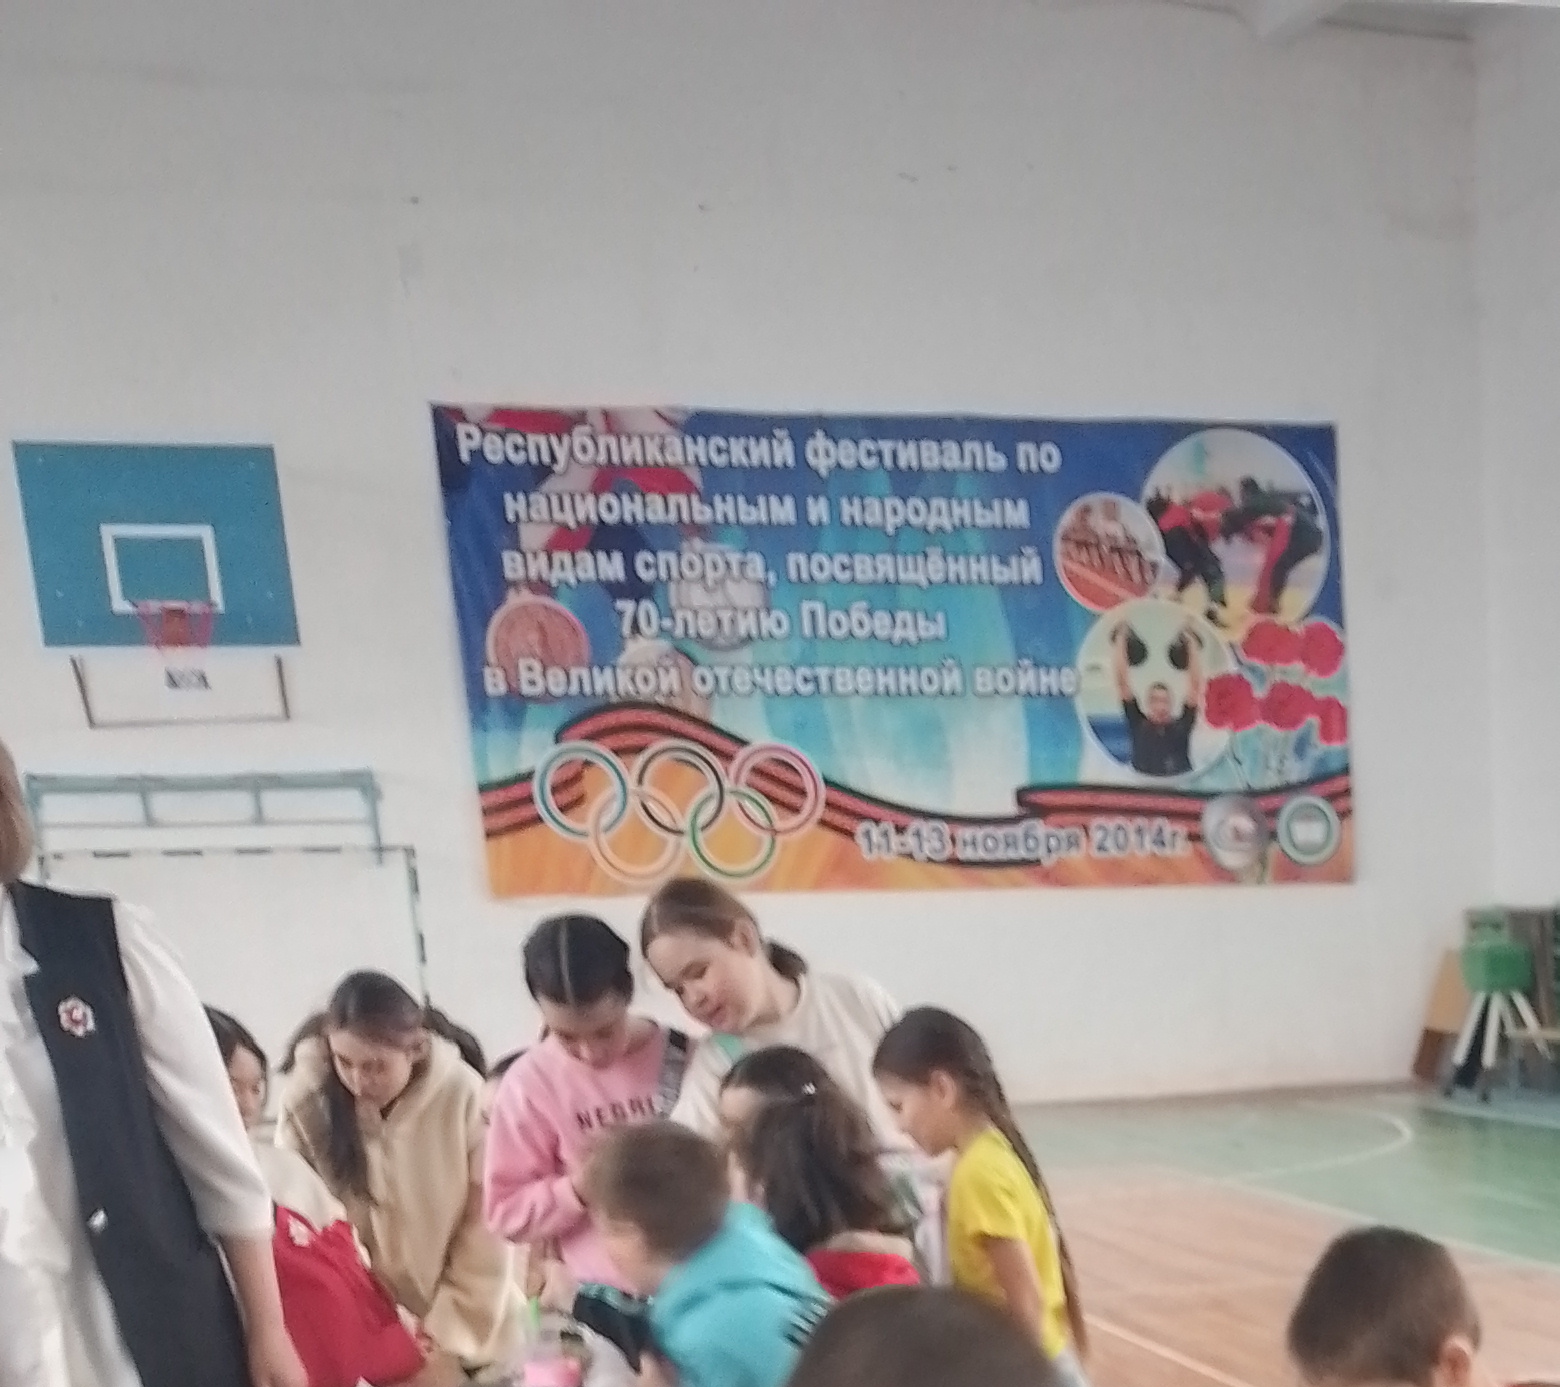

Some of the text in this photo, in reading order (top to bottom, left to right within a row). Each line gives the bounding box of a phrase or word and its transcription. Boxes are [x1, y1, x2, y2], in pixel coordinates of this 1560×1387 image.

[455, 421, 1063, 479] Республиканский фестиваль по
[503, 490, 1032, 536] национальным и народным
[502, 546, 1044, 589] видам спорта, посвящённый
[614, 597, 949, 646] 70-летию Победы
[483, 653, 1080, 698] в Великой отечественной войне
[859, 822, 949, 859] 11-13
[957, 821, 1083, 865] ноября
